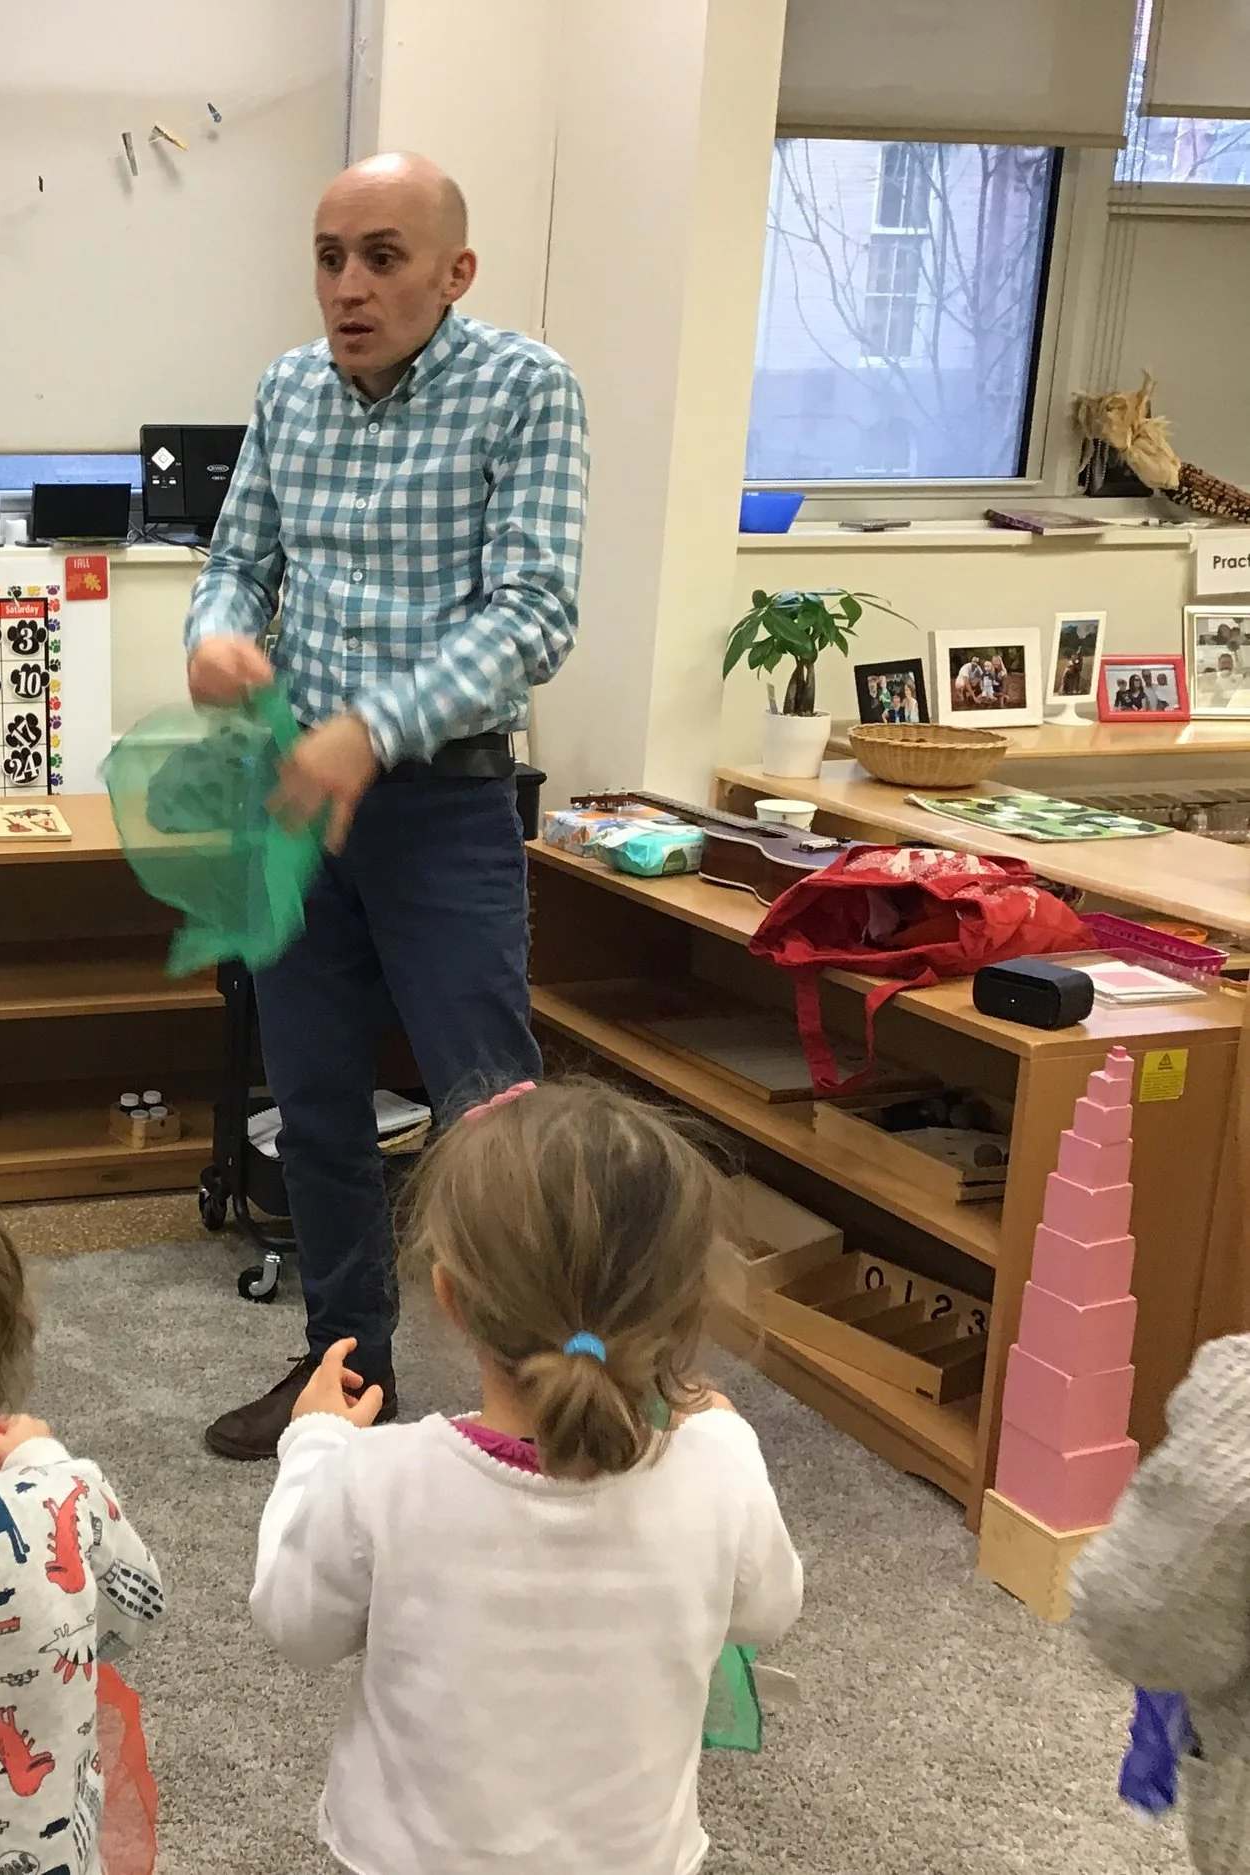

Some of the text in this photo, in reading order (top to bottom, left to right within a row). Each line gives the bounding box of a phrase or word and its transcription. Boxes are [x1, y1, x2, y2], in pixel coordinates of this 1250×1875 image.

[5, 605, 39, 616] Saturday
[18, 628, 33, 652] 3
[18, 672, 41, 696] 10
[10, 720, 37, 748] 17
[9, 755, 39, 782] 24
[865, 1266, 987, 1336] 0 1 2 3
